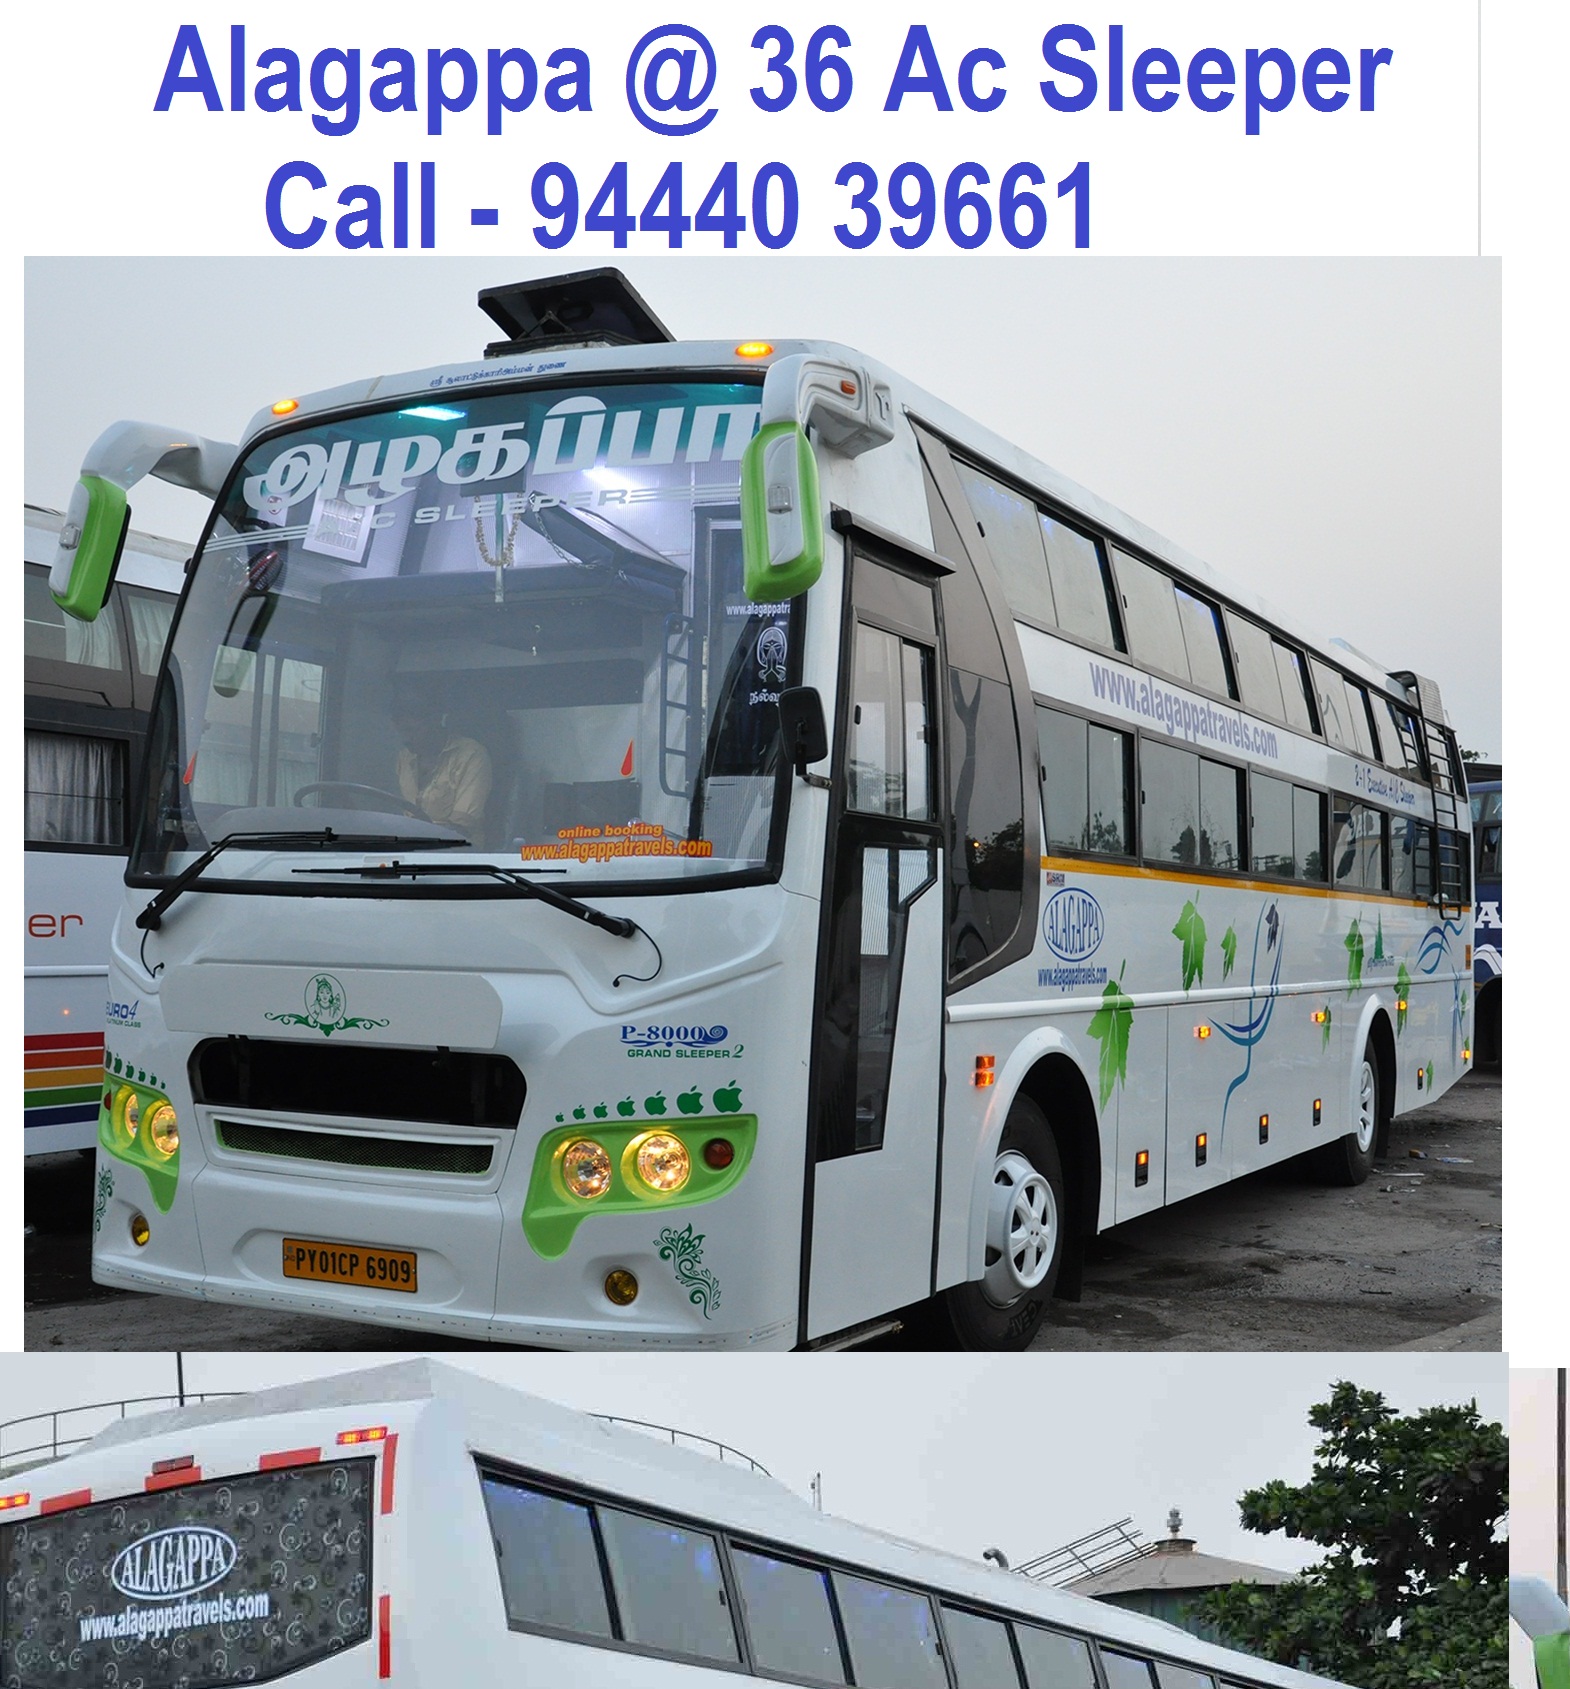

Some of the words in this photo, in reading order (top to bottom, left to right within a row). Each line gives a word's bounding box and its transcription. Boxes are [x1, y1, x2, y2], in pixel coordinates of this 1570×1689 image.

[243, 395, 761, 511] அழகப்பா
[415, 489, 628, 526] SLEEPER
[1089, 662, 1278, 759] www.alagappatravels.com
[520, 836, 713, 862] www.alagappatravels.com
[557, 825, 600, 838] online
[604, 824, 663, 838] booking
[1047, 894, 1100, 955] ALAGAPPA
[620, 1025, 703, 1041] P-8000
[627, 1049, 671, 1058] GRAND
[675, 1049, 730, 1059] SLEEPER
[731, 1044, 744, 1058] 2
[296, 1247, 359, 1277] PY01CP
[366, 1256, 410, 1283] 6909
[121, 1534, 226, 1593] ALAGAPPA
[80, 1592, 270, 1642] www.alagappatravels.com
